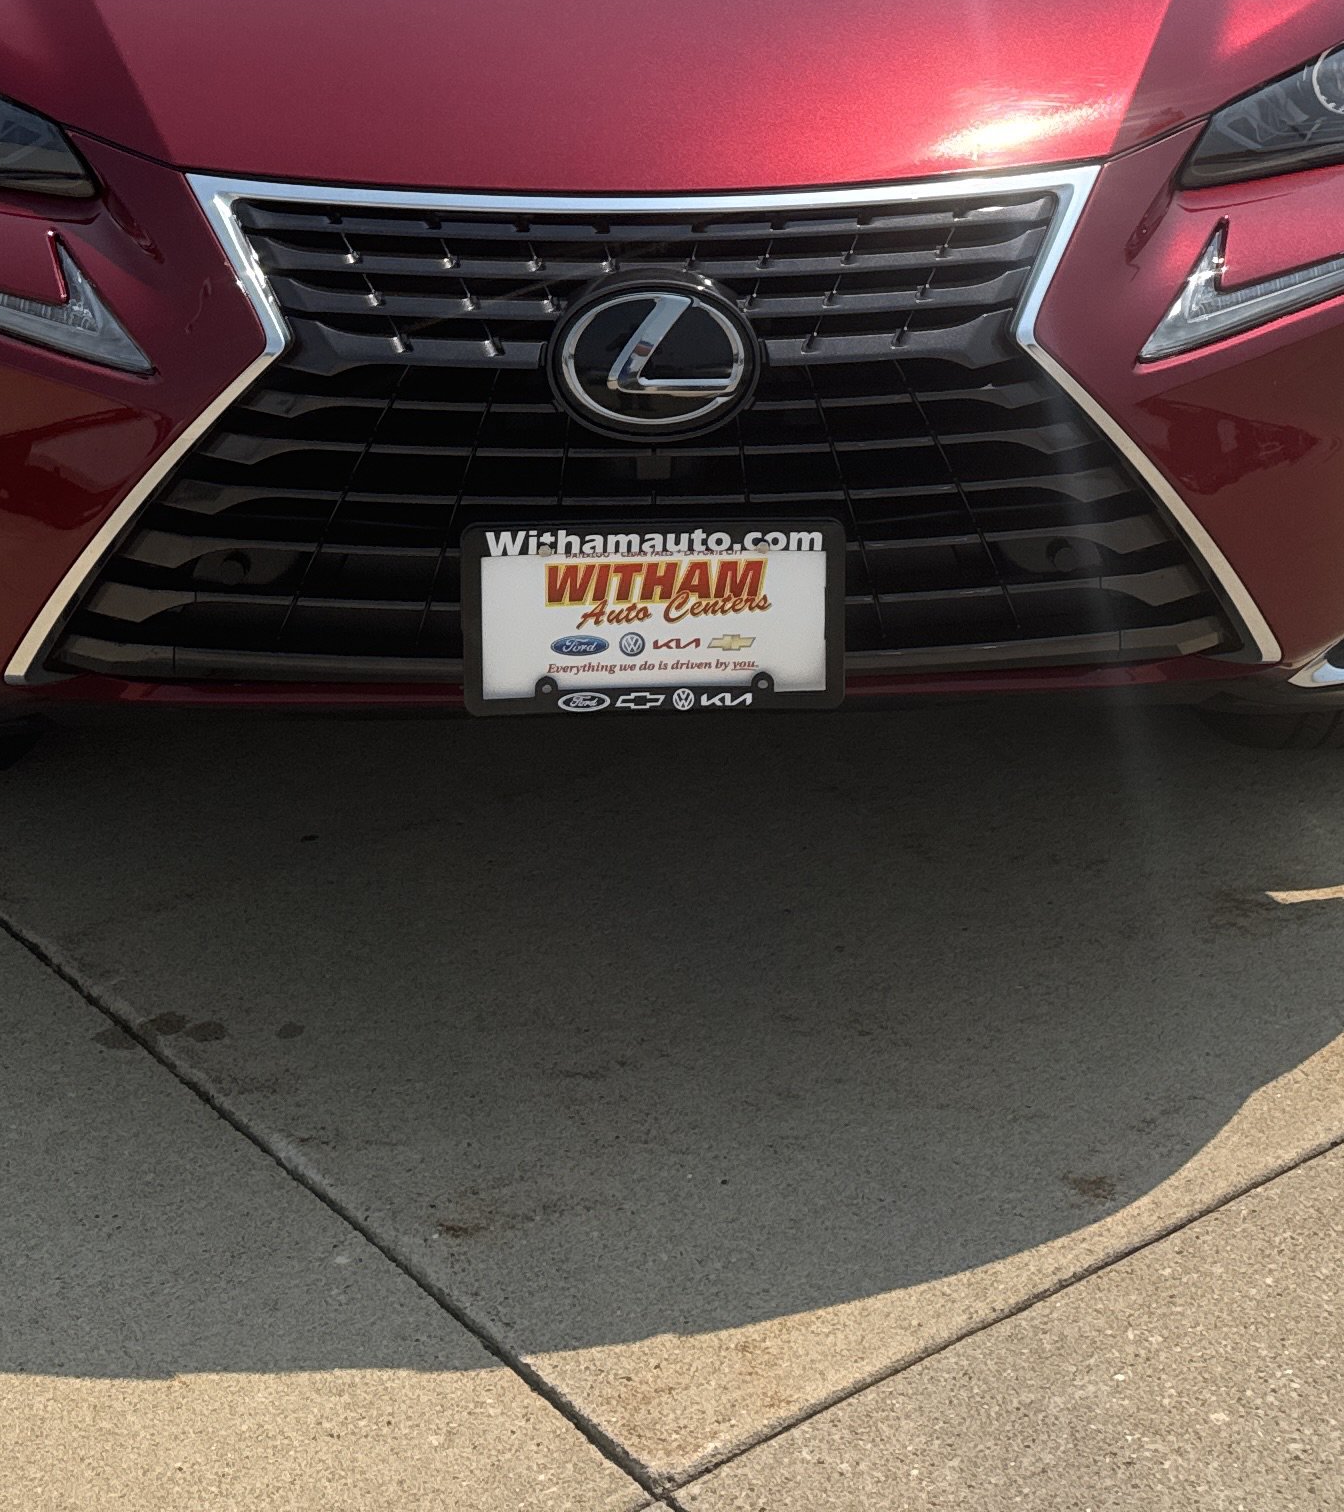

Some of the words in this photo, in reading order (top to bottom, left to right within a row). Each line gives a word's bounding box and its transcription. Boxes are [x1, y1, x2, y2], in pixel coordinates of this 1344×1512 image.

[485, 528, 823, 557] Withamauto.com
[545, 559, 768, 607] WITHAM
[576, 598, 652, 629] Auto
[663, 590, 772, 624] Centers
[561, 638, 598, 653] Ford
[547, 662, 616, 675] Everything
[619, 663, 637, 672] we
[639, 661, 655, 671] do
[658, 660, 668, 671] is
[670, 659, 712, 671] driven
[715, 659, 730, 671] by
